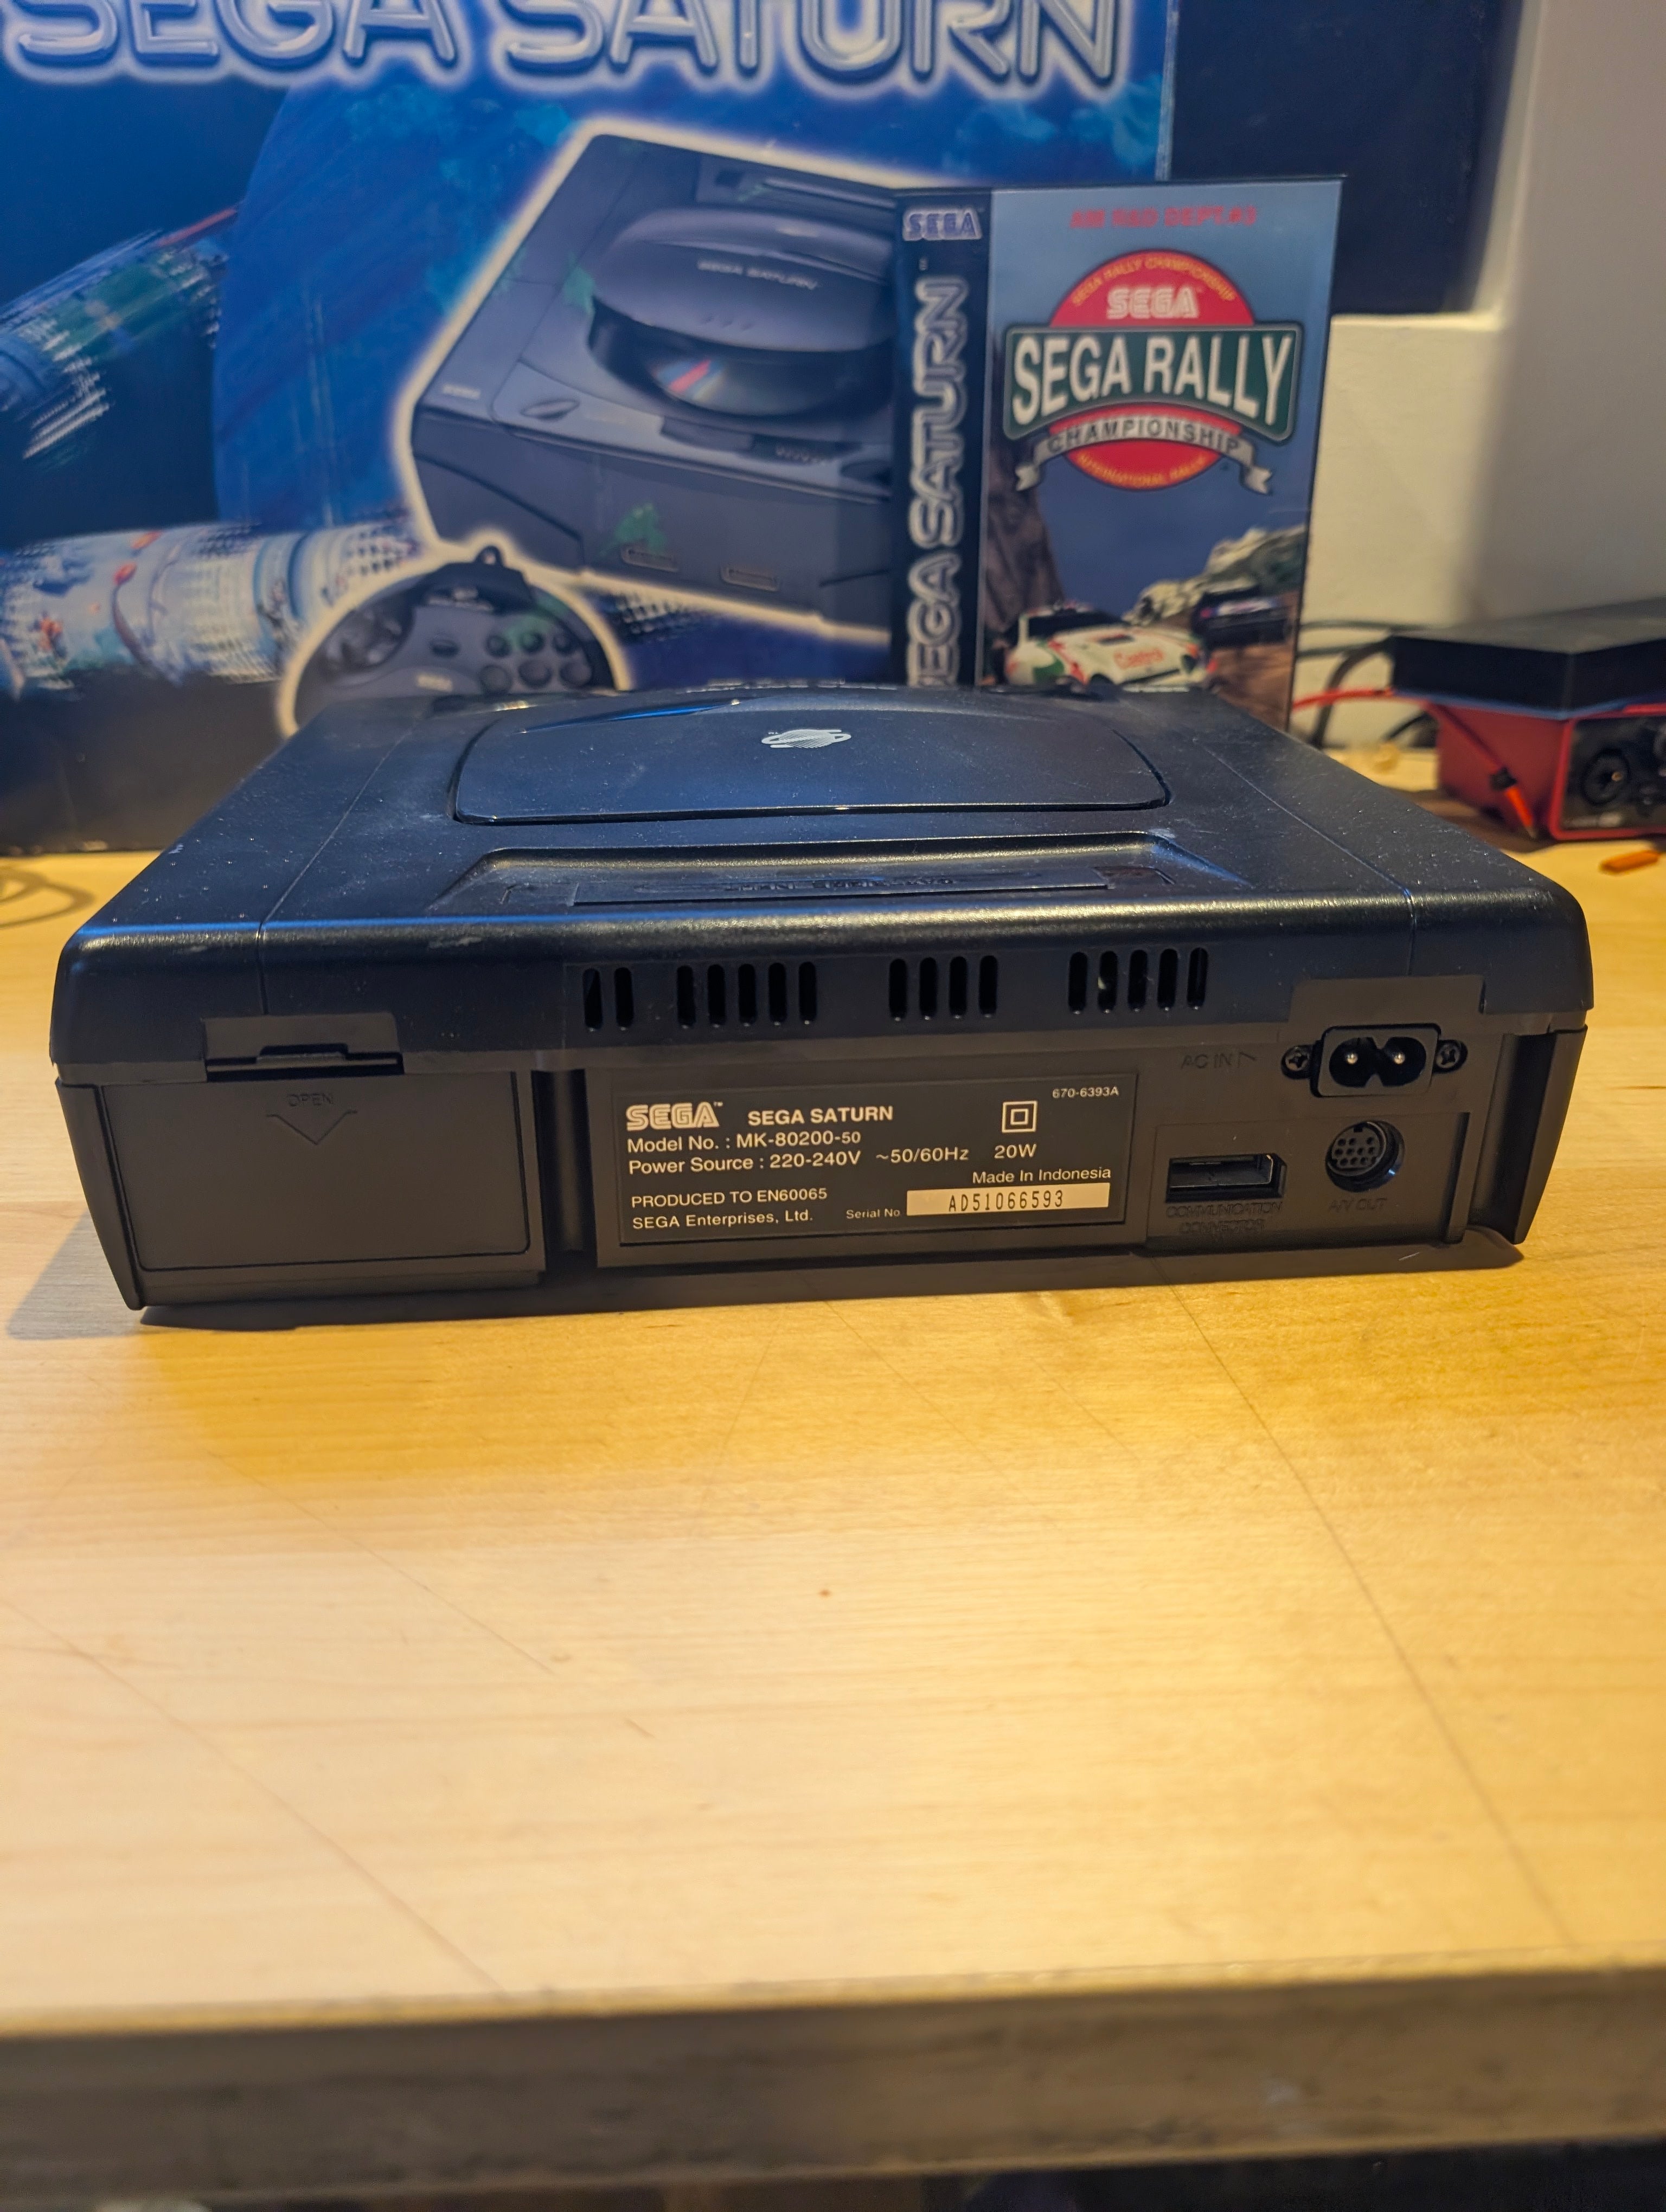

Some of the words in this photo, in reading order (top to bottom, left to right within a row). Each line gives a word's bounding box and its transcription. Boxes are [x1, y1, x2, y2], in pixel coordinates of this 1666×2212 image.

[902, 208, 983, 241] SEGA
[1106, 285, 1199, 320] SEGA
[1012, 335, 1132, 426] SEGA
[1143, 335, 1293, 427] RALLY
[909, 274, 970, 549] SATURN
[1047, 417, 1241, 455] CHAMPIONSHIP
[906, 552, 962, 686] EGA
[287, 1093, 333, 1107] OPEN
[1052, 1086, 1119, 1098] 670-6393A
[625, 1101, 720, 1132] SEGA
[747, 1109, 805, 1126] SEGA
[810, 1105, 893, 1124] SATURN
[627, 1136, 682, 1153] Model
[688, 1135, 719, 1150] No.
[736, 1130, 861, 1148] MK-80200-50
[629, 1160, 685, 1175] Power
[690, 1156, 754, 1172] Source
[770, 1150, 861, 1168] 220-240V
[994, 1143, 1037, 1159] 20W
[972, 1171, 1015, 1184] Made
[1020, 1169, 1033, 1182] In
[1039, 1167, 1111, 1181] Indonesia
[631, 1192, 725, 1208] PRODUCED
[729, 1191, 753, 1203] TO
[757, 1187, 828, 1203] EN60065
[845, 1208, 881, 1220] Serial
[948, 1189, 1065, 1212] AD51066593
[632, 1216, 680, 1229] SEGA
[685, 1212, 779, 1227] Enterprises,
[785, 1209, 813, 1222] Ltd.
